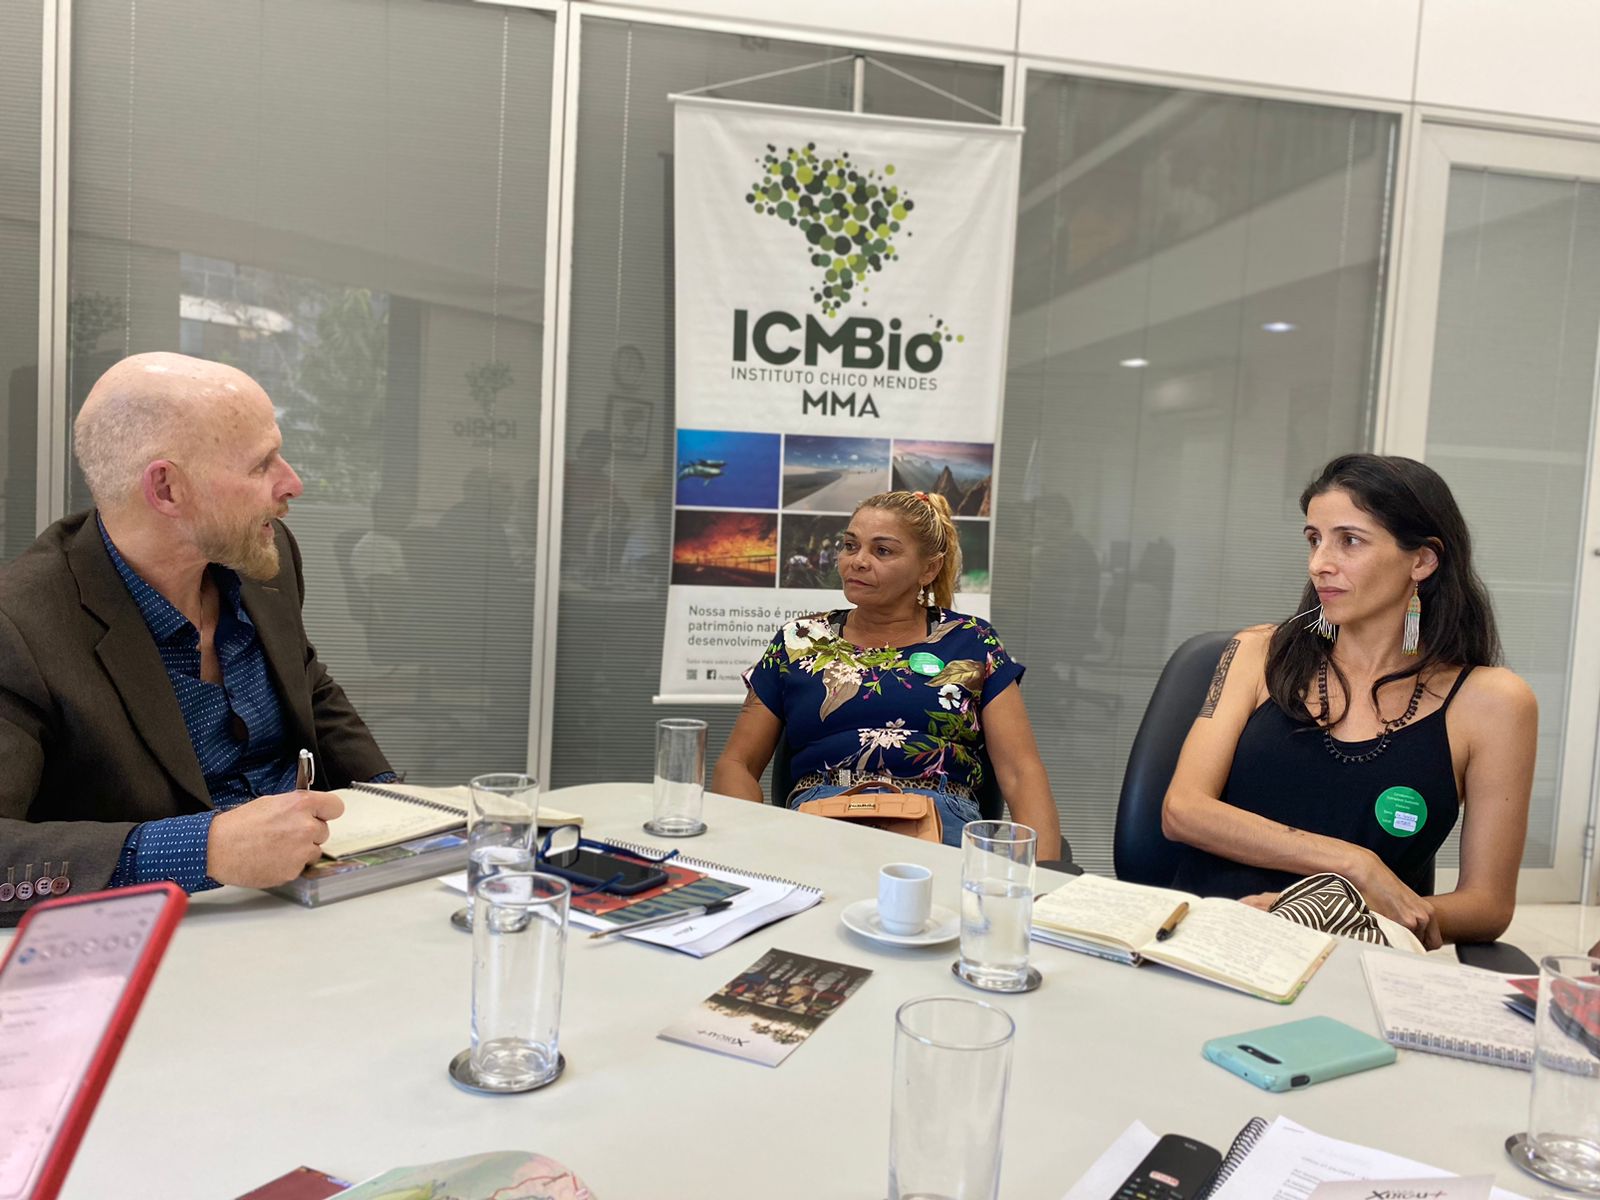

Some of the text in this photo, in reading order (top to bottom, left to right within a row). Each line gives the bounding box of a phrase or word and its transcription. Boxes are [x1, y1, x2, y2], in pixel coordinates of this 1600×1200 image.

[732, 309, 943, 374] ICMBio
[731, 367, 938, 391] INSTITUTO CHICO MENDES
[802, 389, 880, 418] MMA
[688, 605, 816, 621] Nossa missão é prote
[688, 621, 783, 633] patrimônio natu
[687, 635, 769, 647] desenvolvime
